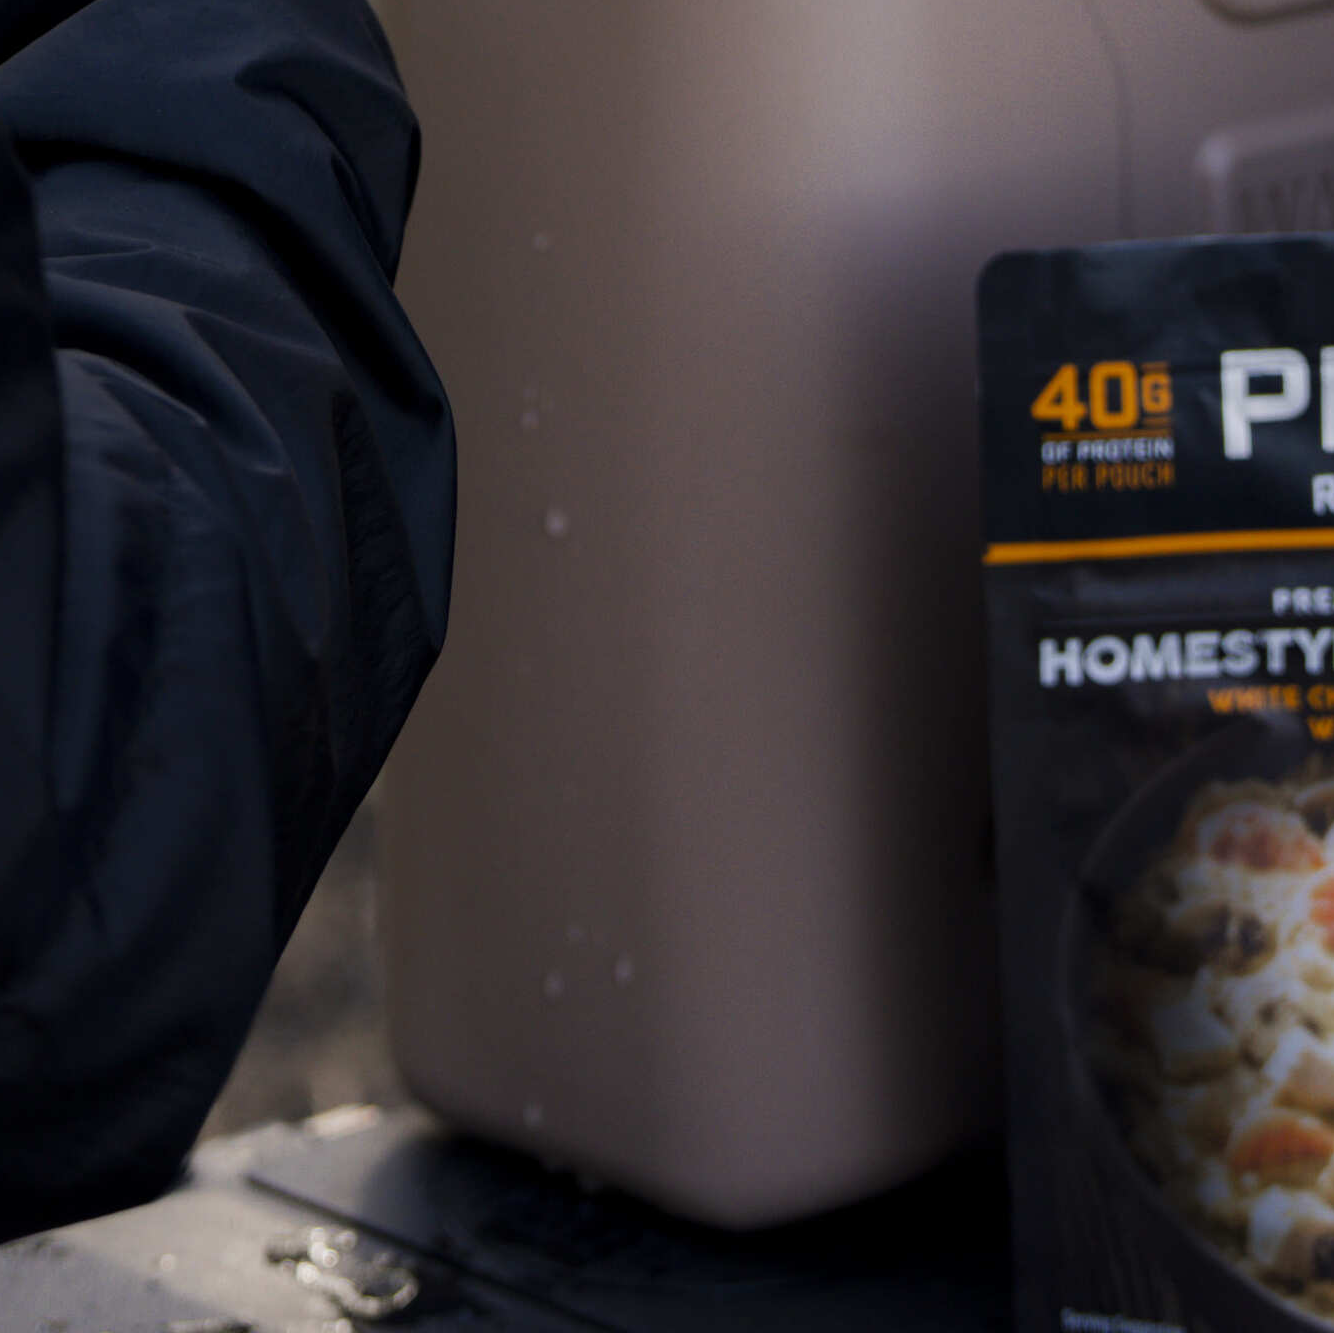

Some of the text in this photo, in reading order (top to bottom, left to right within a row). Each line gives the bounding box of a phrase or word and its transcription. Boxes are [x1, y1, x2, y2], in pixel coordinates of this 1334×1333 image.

[1041, 437, 1175, 465] OF PROTEIN
[1042, 460, 1176, 493] PER POUCH
[1206, 685, 1301, 715] WHITE
